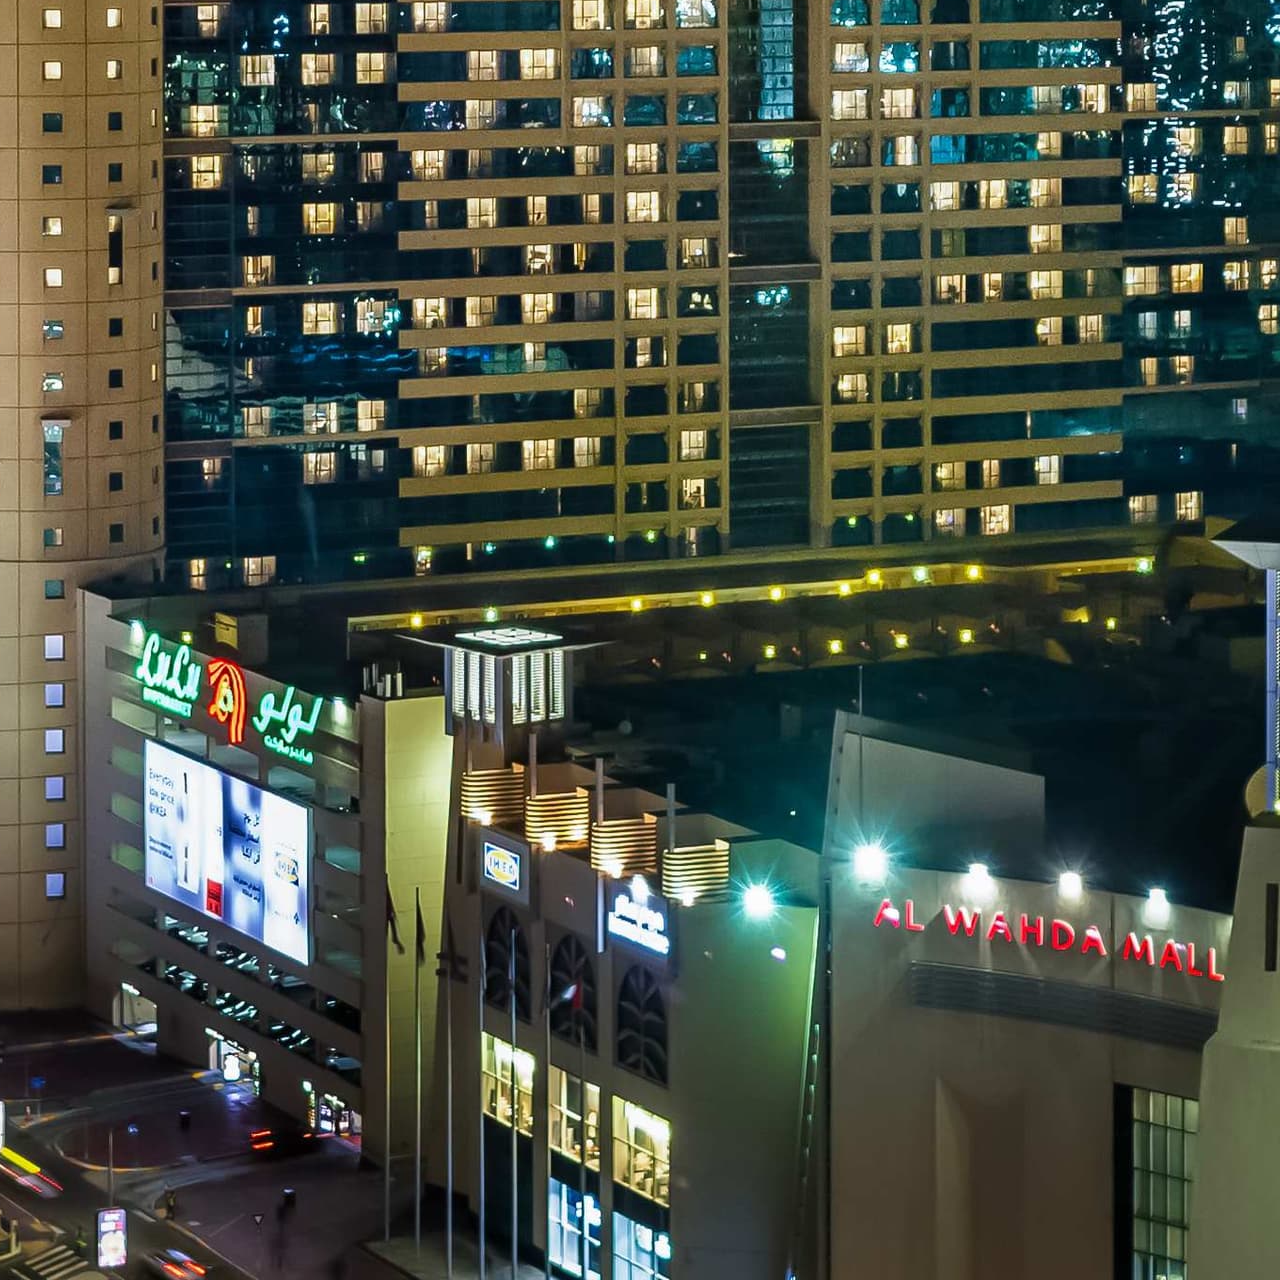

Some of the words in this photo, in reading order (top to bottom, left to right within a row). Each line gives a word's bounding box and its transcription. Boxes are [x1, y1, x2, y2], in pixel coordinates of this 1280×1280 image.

[252, 686, 324, 744] لولو
[873, 898, 925, 932] AL
[943, 904, 1108, 957] WAHDA
[1123, 931, 1225, 982] MALL
